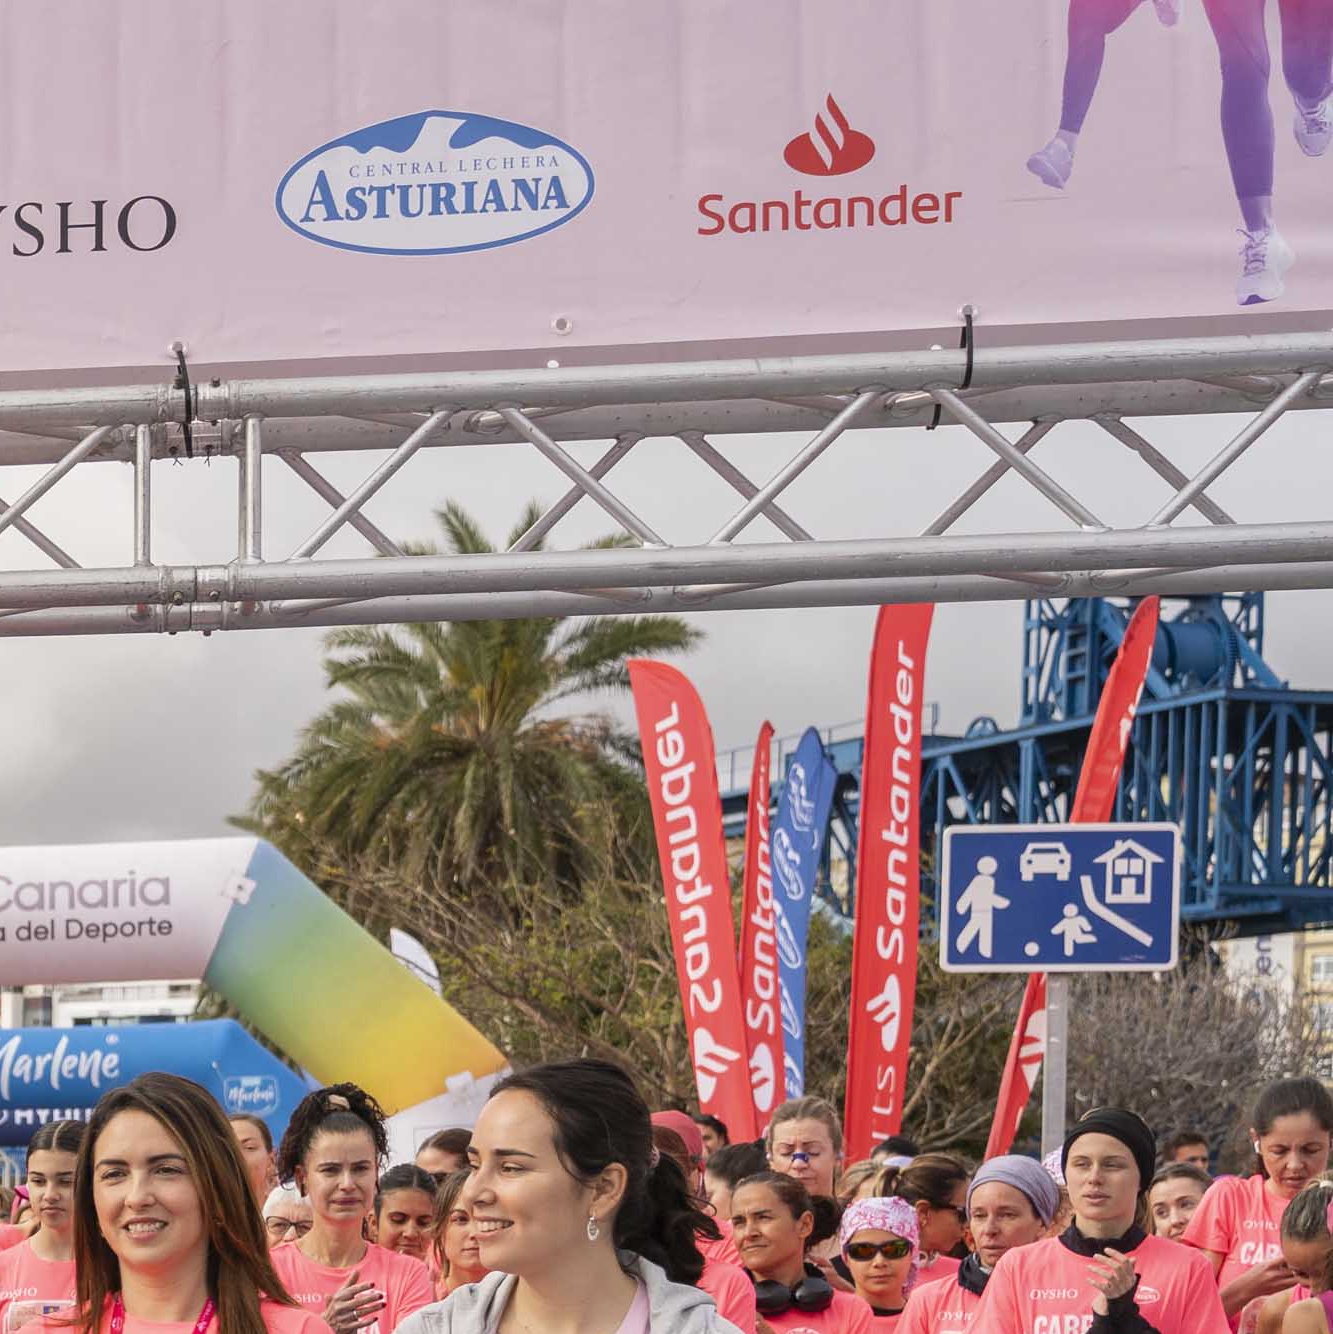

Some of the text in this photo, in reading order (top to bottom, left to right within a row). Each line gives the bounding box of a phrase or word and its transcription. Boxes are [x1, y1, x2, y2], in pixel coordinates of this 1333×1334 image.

[348, 153, 562, 179] CENTRAL LECHERA
[299, 168, 570, 225] ASTURIANA
[697, 184, 962, 237] Santander
[876, 640, 914, 966] Santander
[746, 750, 775, 1036] Santan
[14, 915, 57, 944] del
[64, 913, 173, 948] Deporte
[294, 1292, 322, 1303] SHO
[1030, 1288, 1078, 1301] OYSHO
